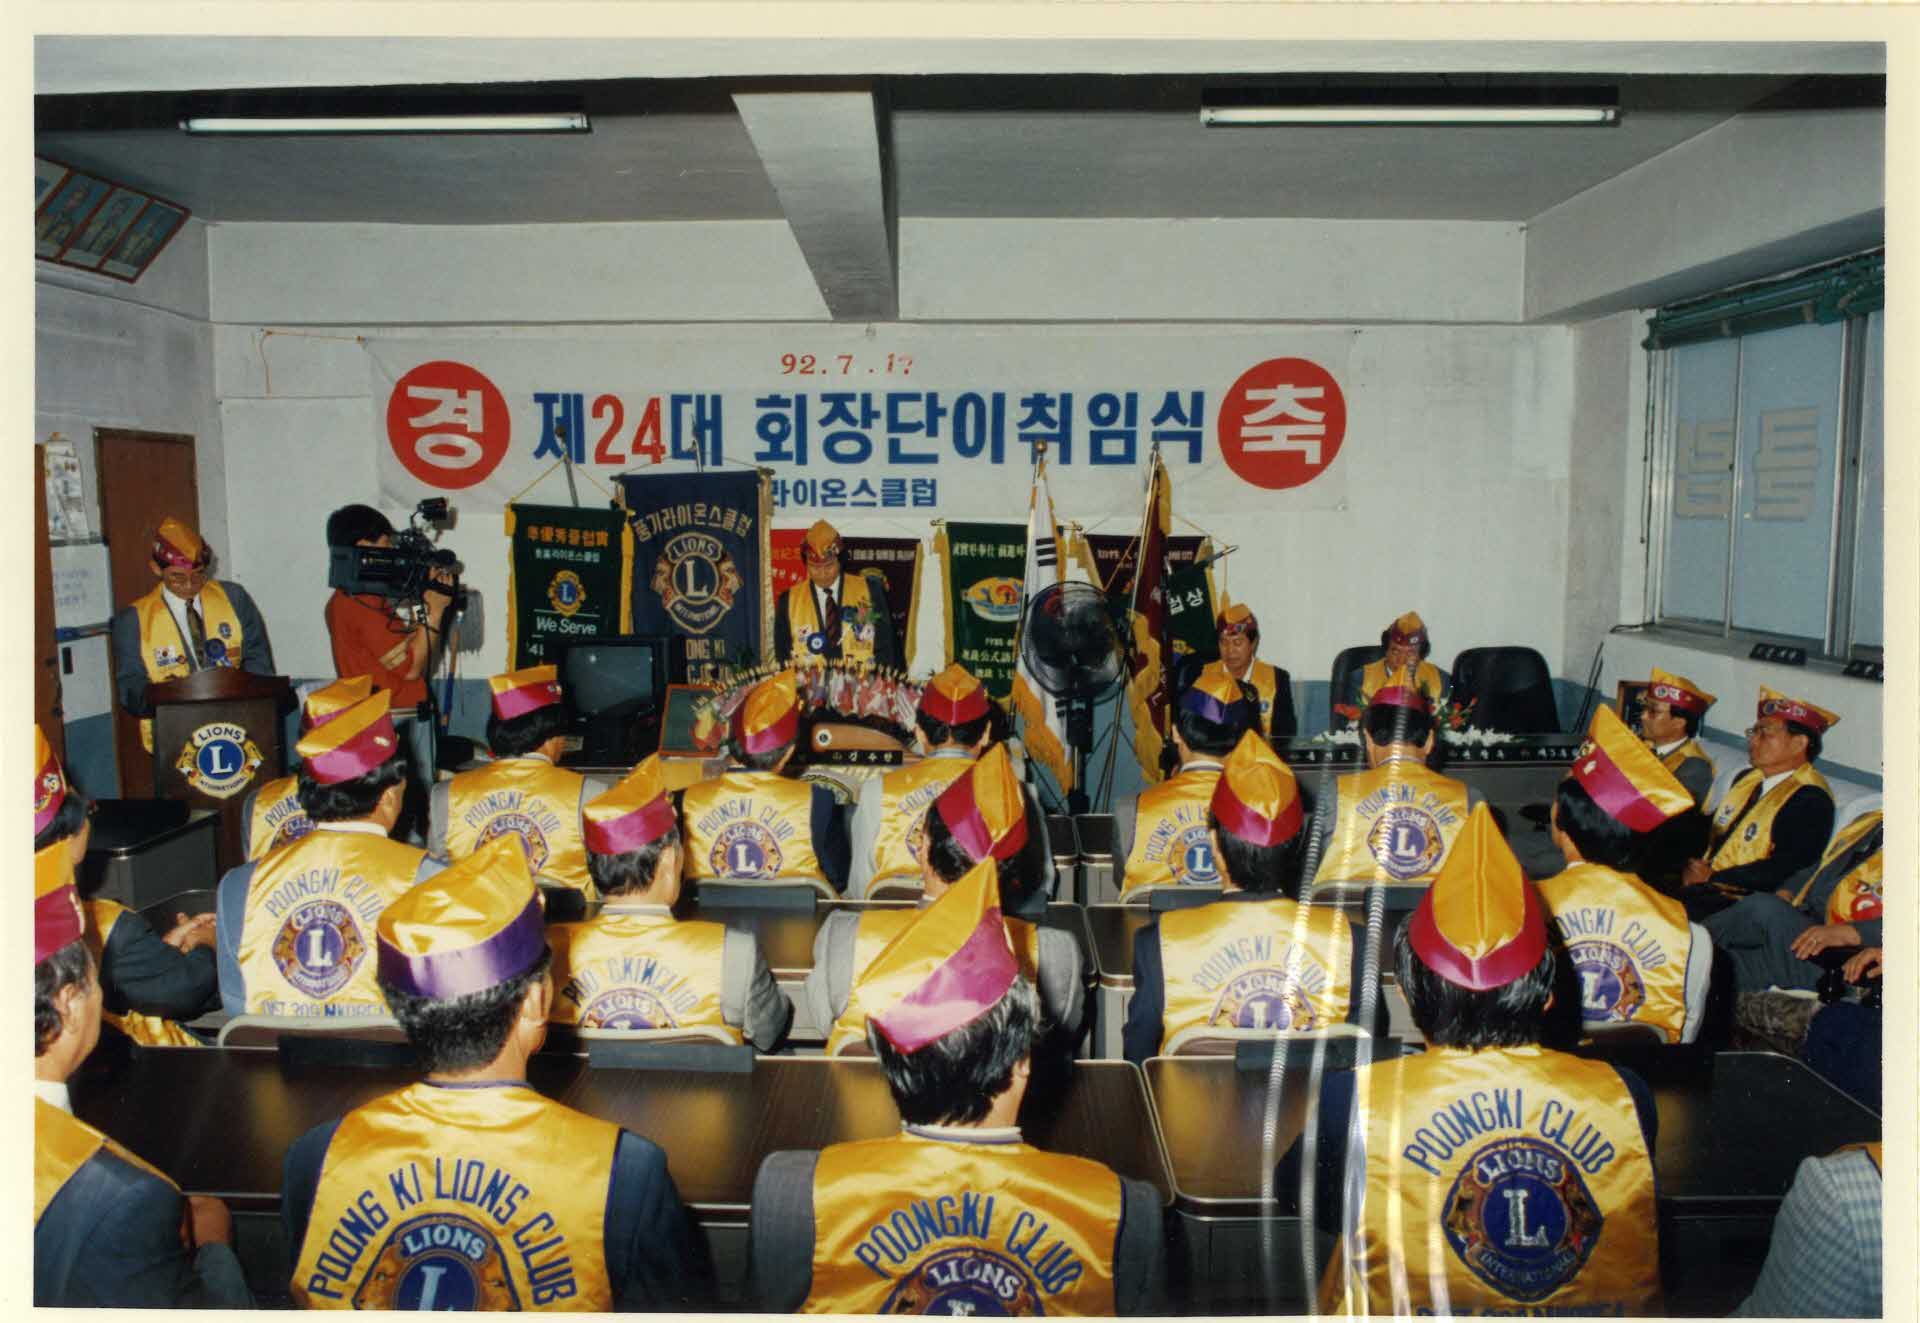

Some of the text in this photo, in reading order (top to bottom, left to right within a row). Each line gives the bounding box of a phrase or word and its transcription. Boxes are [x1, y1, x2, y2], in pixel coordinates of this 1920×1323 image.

[407, 384, 483, 469] 경
[533, 392, 724, 464] 제24대
[1240, 383, 1327, 465] 축
[672, 536, 717, 556] LIONS
[684, 559, 708, 598] L
[536, 615, 598, 635] We Serve
[197, 726, 242, 741] LIONS
[208, 745, 234, 775] L
[464, 790, 524, 830] POONGKI
[697, 797, 753, 838] POONGKI
[735, 843, 758, 873] L
[1192, 847, 1215, 873] L
[1394, 826, 1418, 857] L
[264, 868, 341, 918] POONGKI
[305, 929, 334, 968] L
[1192, 935, 1272, 993] POONGKI
[1621, 921, 1667, 971] CLUB
[1582, 971, 1608, 1009] L
[1402, 1087, 1616, 1177] POONGKI CLUB
[1476, 1148, 1560, 1183] LIONS
[307, 1156, 578, 1307] POONG KI LIONS CLUB
[1502, 1189, 1549, 1247] L
[404, 1223, 488, 1261] LIONS
[853, 1191, 1084, 1295] POONGKI CLUB
[929, 1257, 1022, 1299] LIONS
